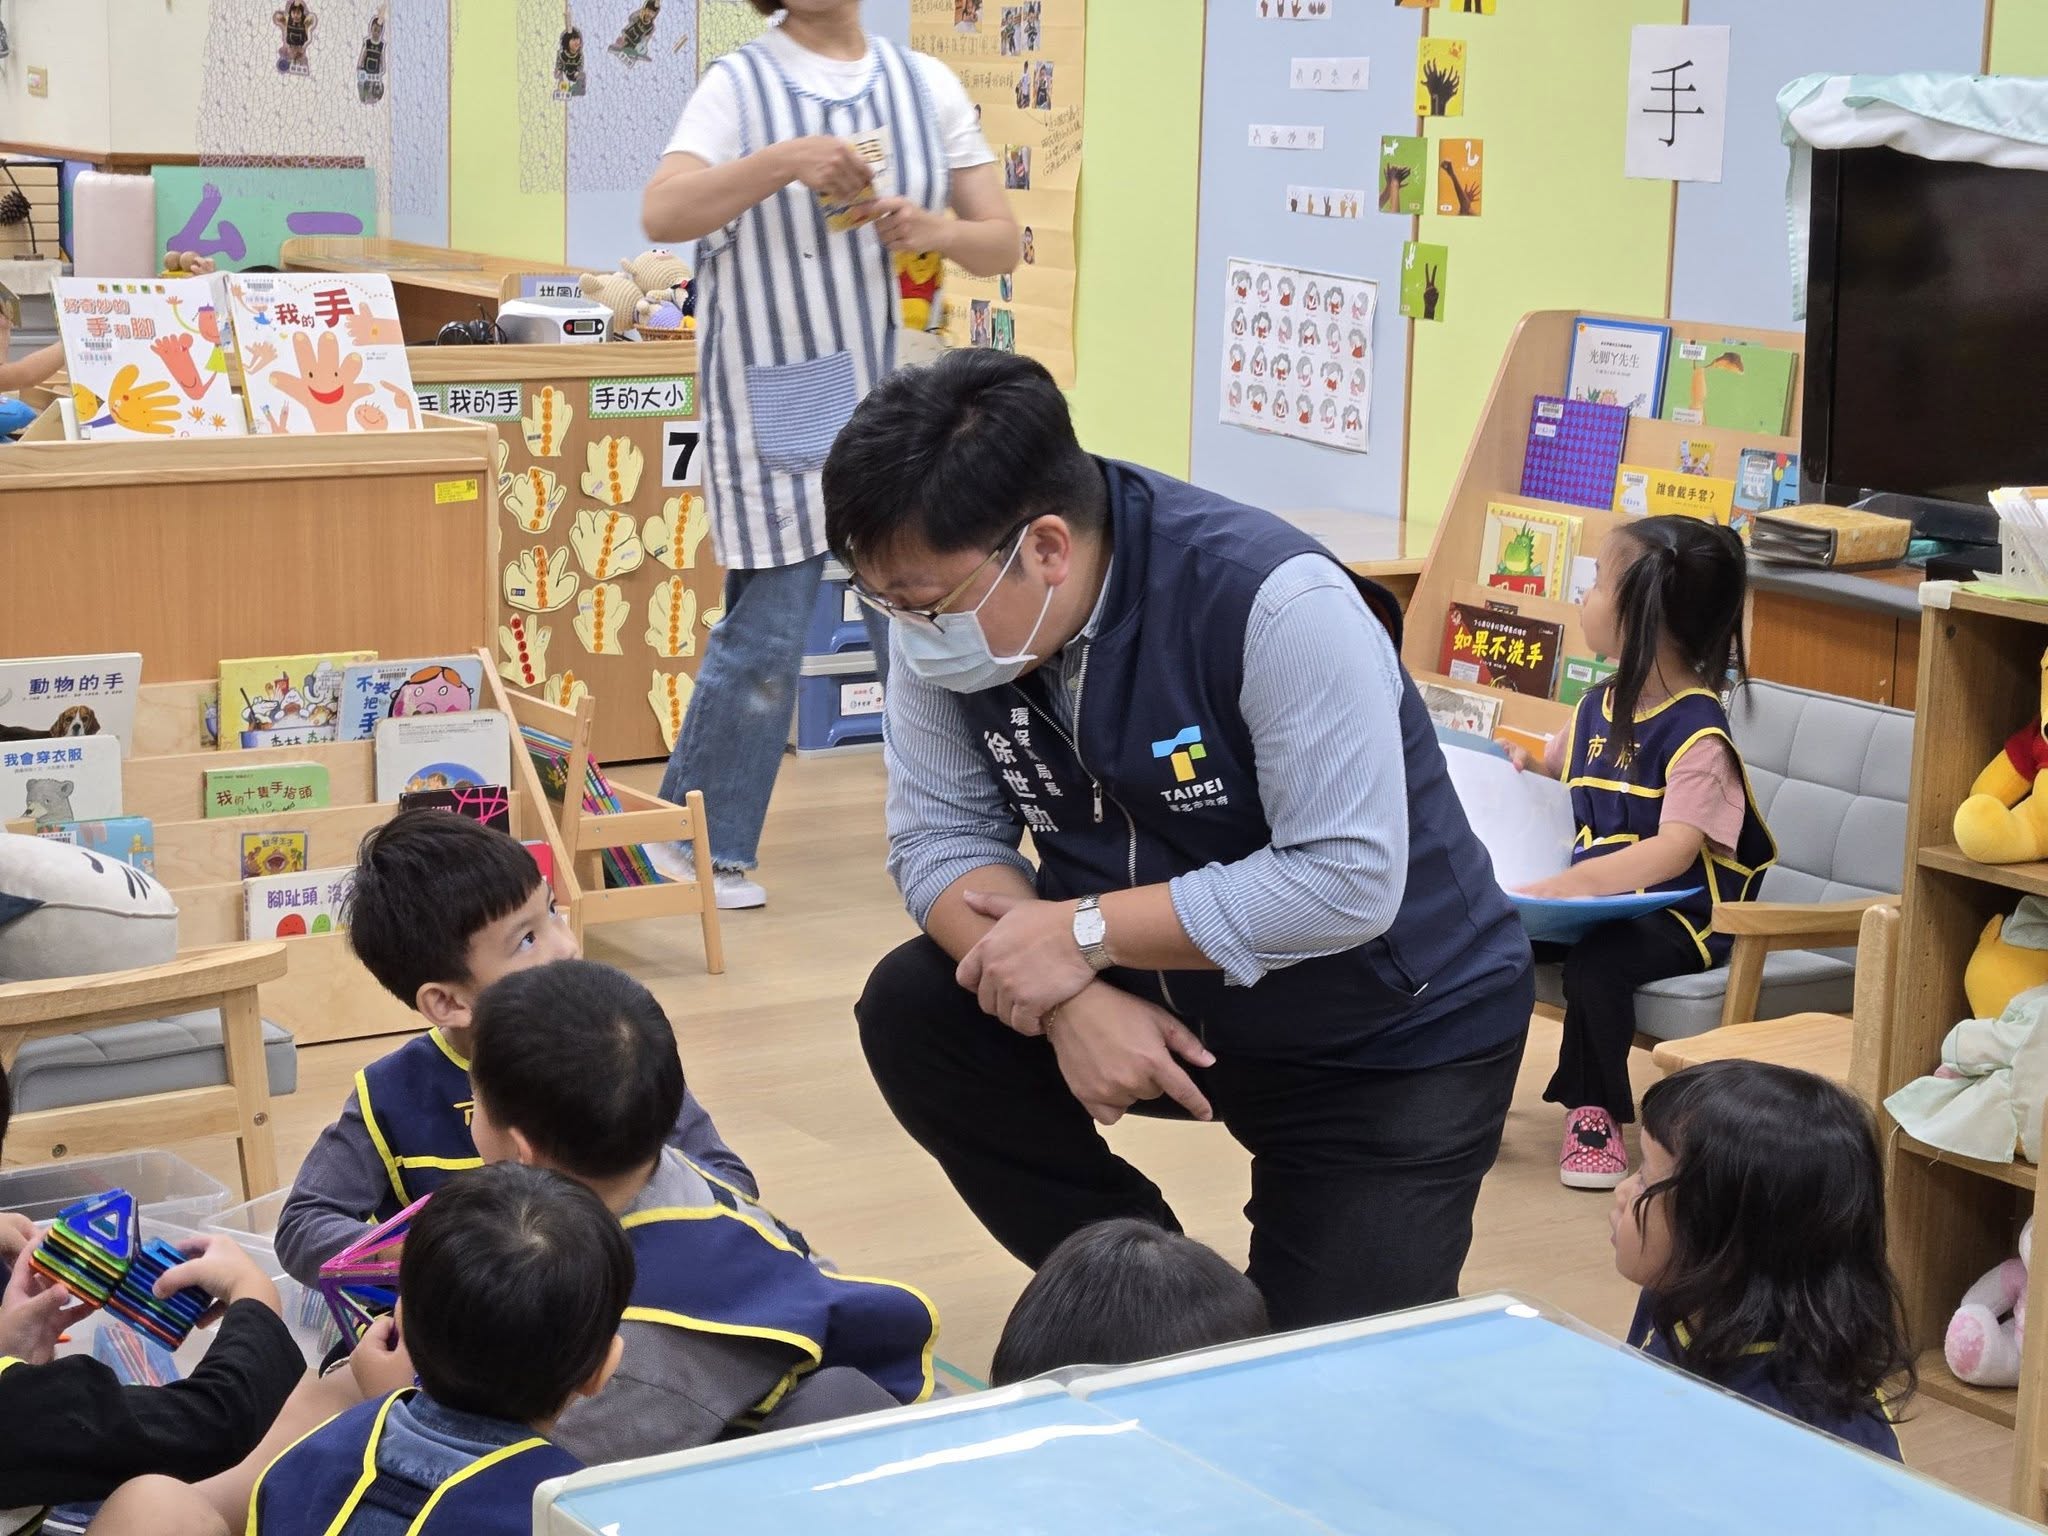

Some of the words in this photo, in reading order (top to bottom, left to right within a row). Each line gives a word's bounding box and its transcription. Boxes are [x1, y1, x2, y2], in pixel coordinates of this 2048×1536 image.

[1643, 60, 1704, 147] 手
[539, 285, 583, 298] 拼圖
[274, 288, 355, 329] 我的手
[449, 388, 519, 414] 我的手
[594, 383, 685, 411] 手的大小
[668, 431, 701, 481] 7
[1453, 626, 1544, 670] 如果不洗手
[28, 672, 124, 696] 動物的手
[4, 747, 83, 768] 我會穿衣服
[1159, 777, 1225, 802] TAIPEI
